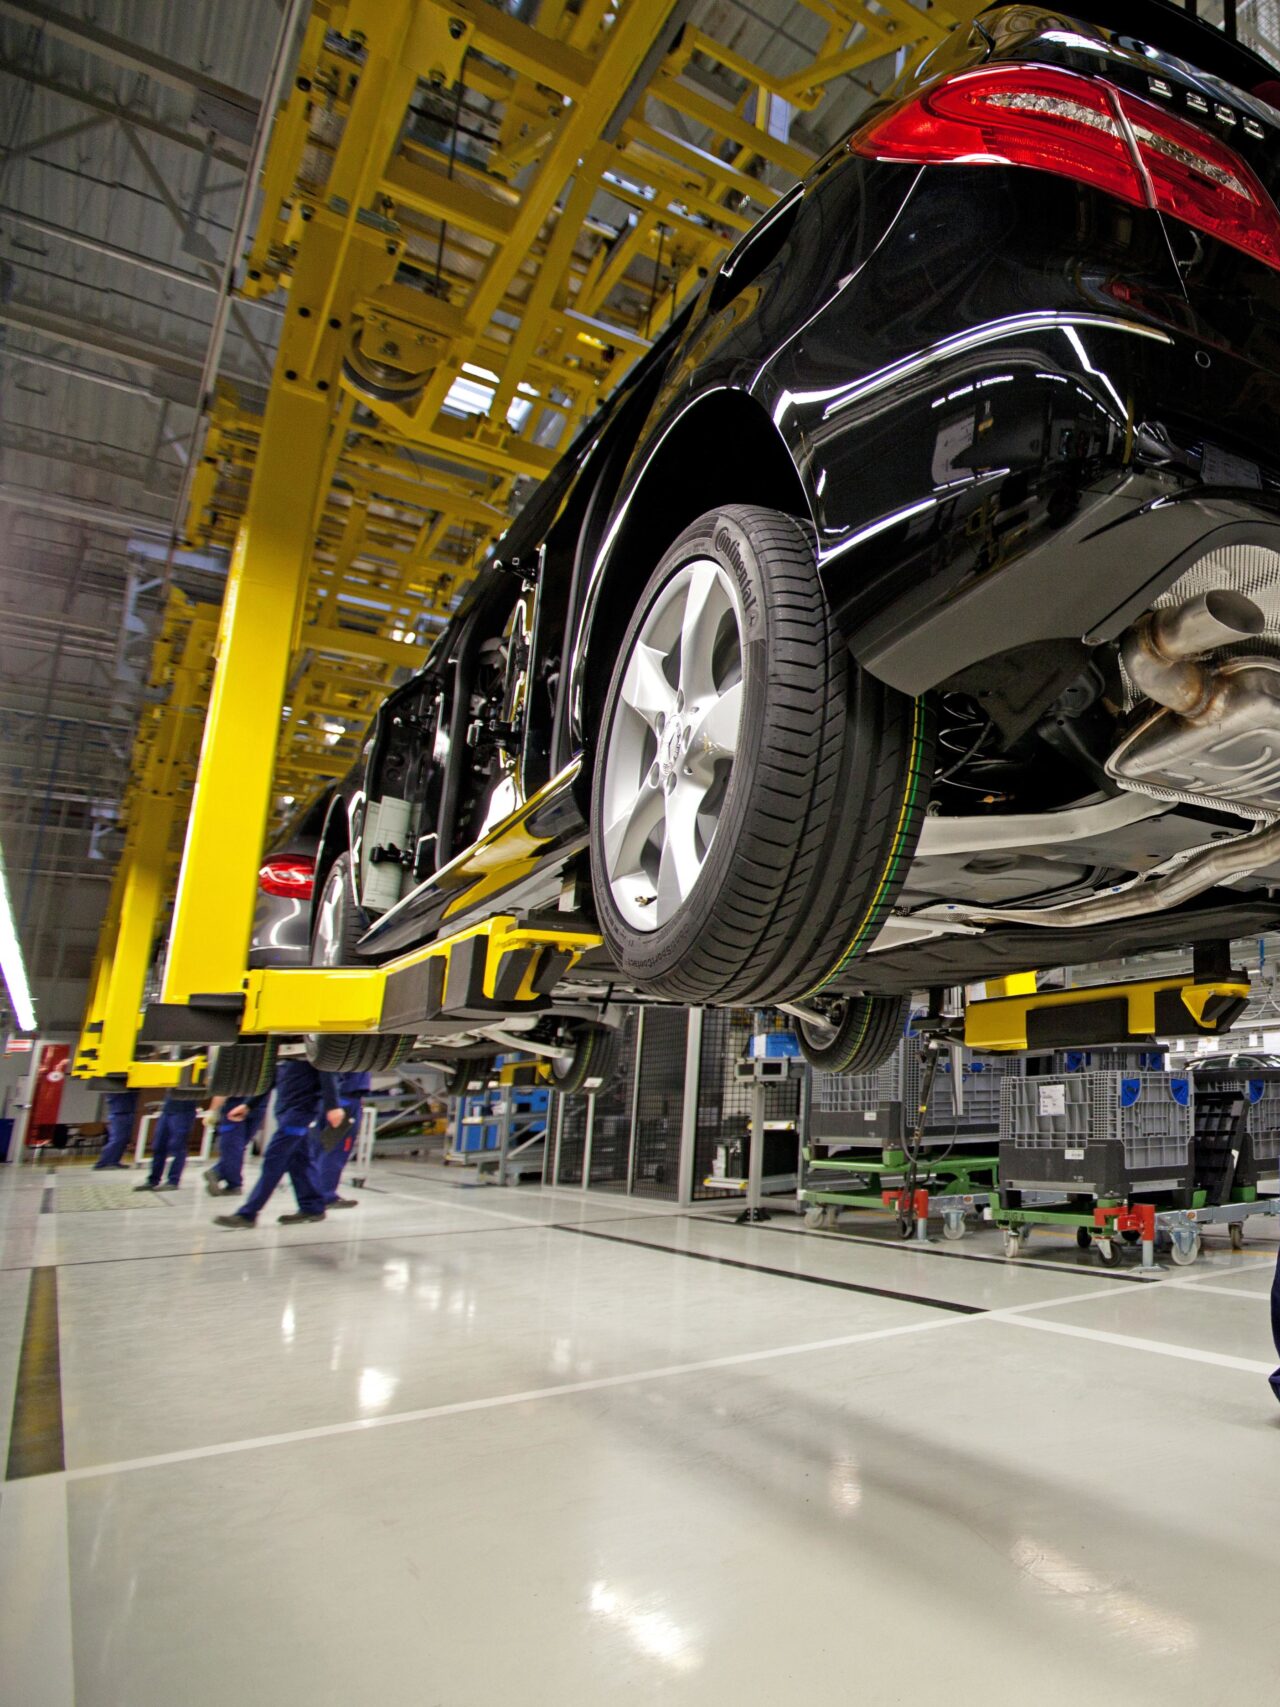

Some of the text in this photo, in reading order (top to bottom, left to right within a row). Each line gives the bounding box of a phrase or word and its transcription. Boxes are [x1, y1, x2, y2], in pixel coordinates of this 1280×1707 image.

[1147, 76, 1265, 139] B 200
[715, 526, 757, 613] Continental
